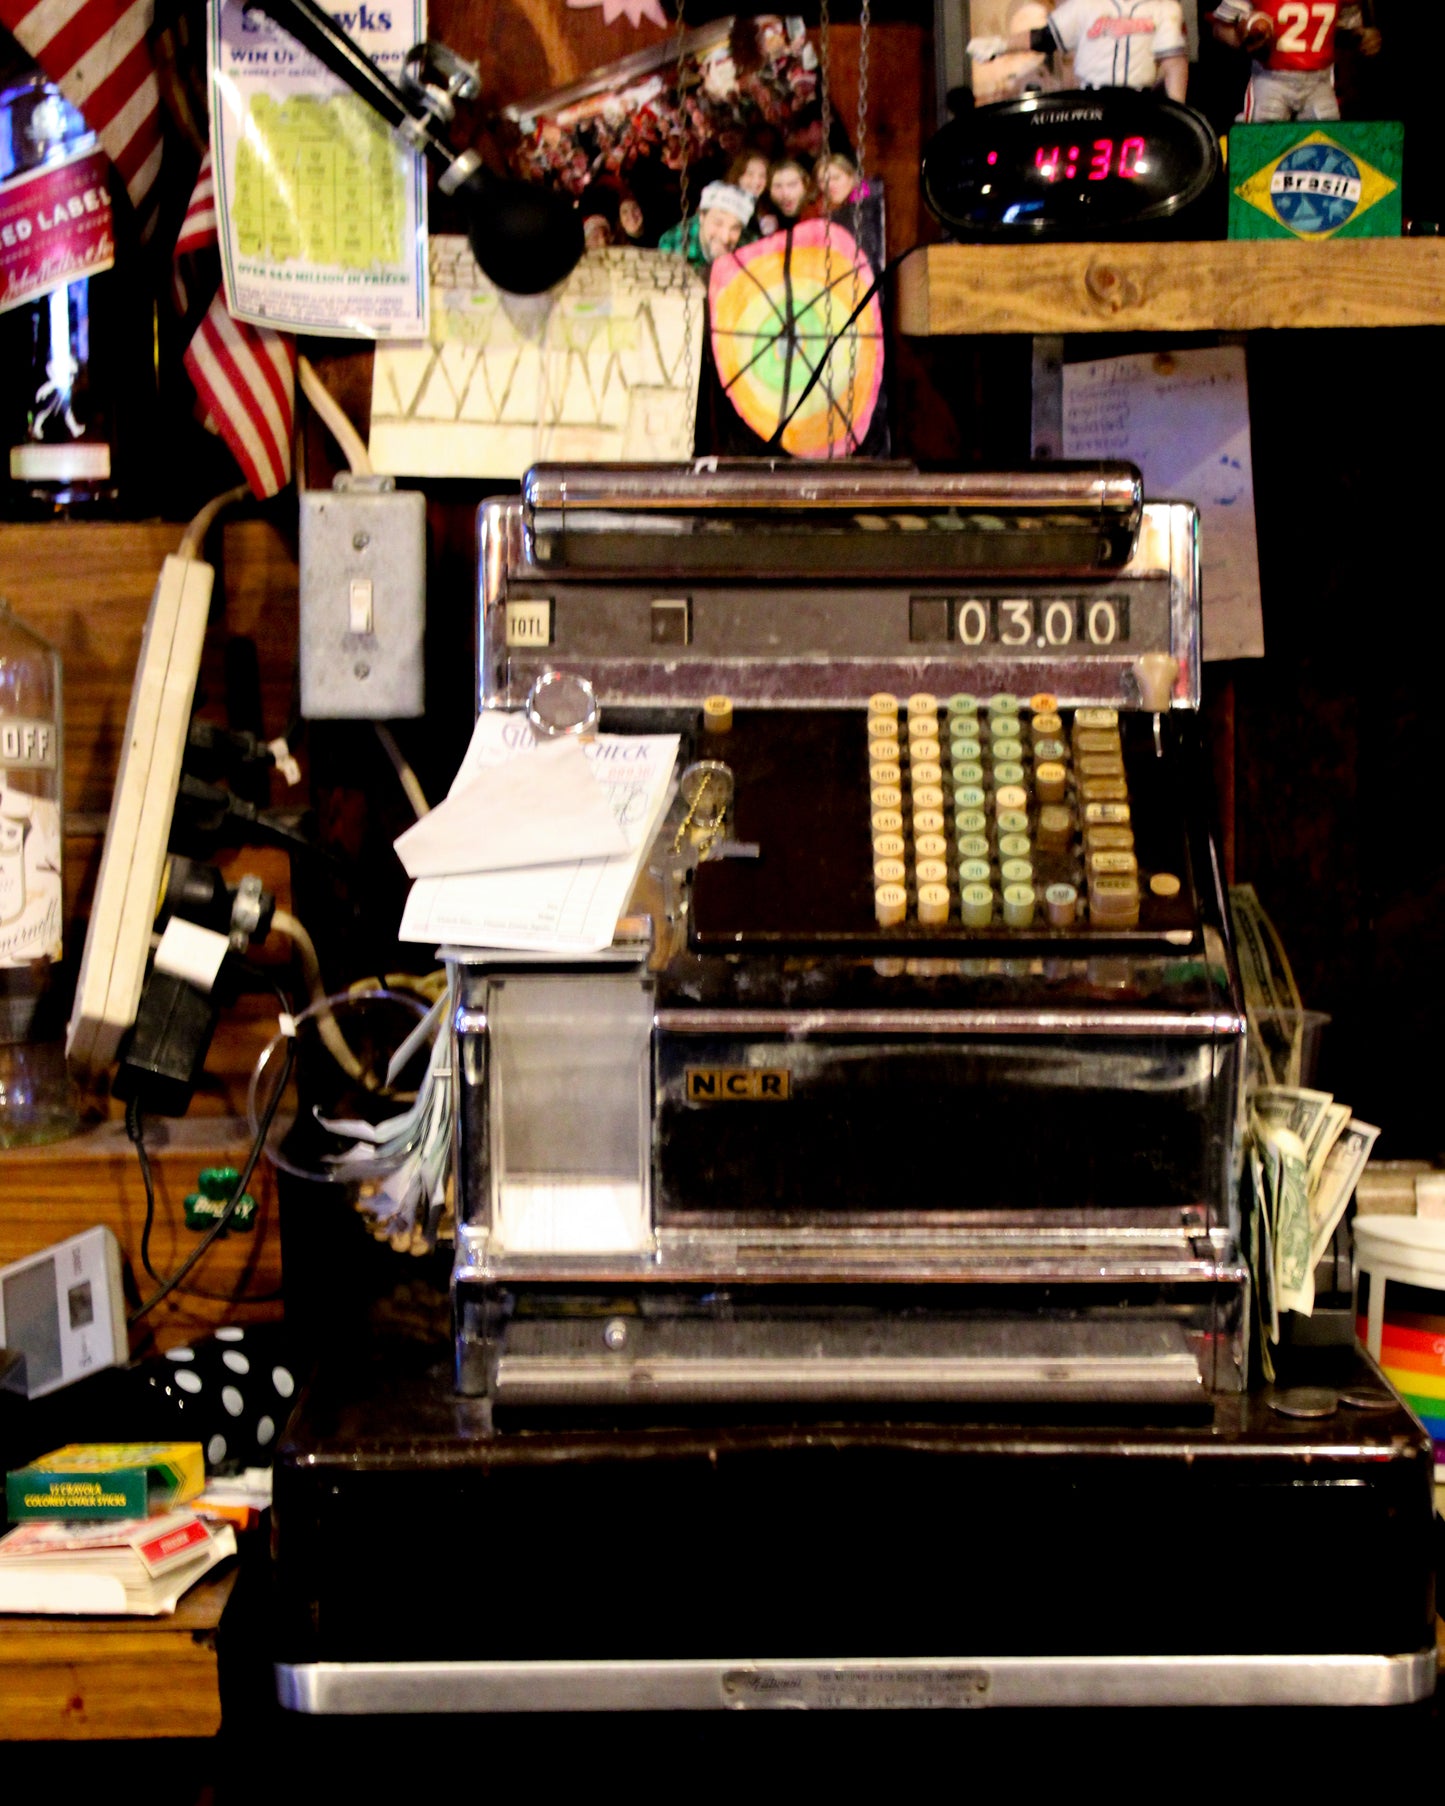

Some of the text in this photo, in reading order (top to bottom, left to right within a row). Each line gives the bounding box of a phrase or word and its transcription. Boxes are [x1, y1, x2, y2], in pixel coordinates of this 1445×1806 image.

[1276, 4, 1336, 53] 27
[231, 50, 267, 64] WIN
[1030, 108, 1104, 126] AUDIOVOX
[1035, 136, 1145, 183] 4:30
[1283, 173, 1349, 197] Brasil
[0, 217, 33, 248] ED
[36, 185, 112, 232] LABEL
[510, 616, 544, 638] TOTL
[3, 725, 49, 763] OFF
[693, 1074, 781, 1095] NCR
[60, 1482, 103, 1496] CRAYOLA
[24, 1493, 127, 1508] COLORED CHALK STICKS
